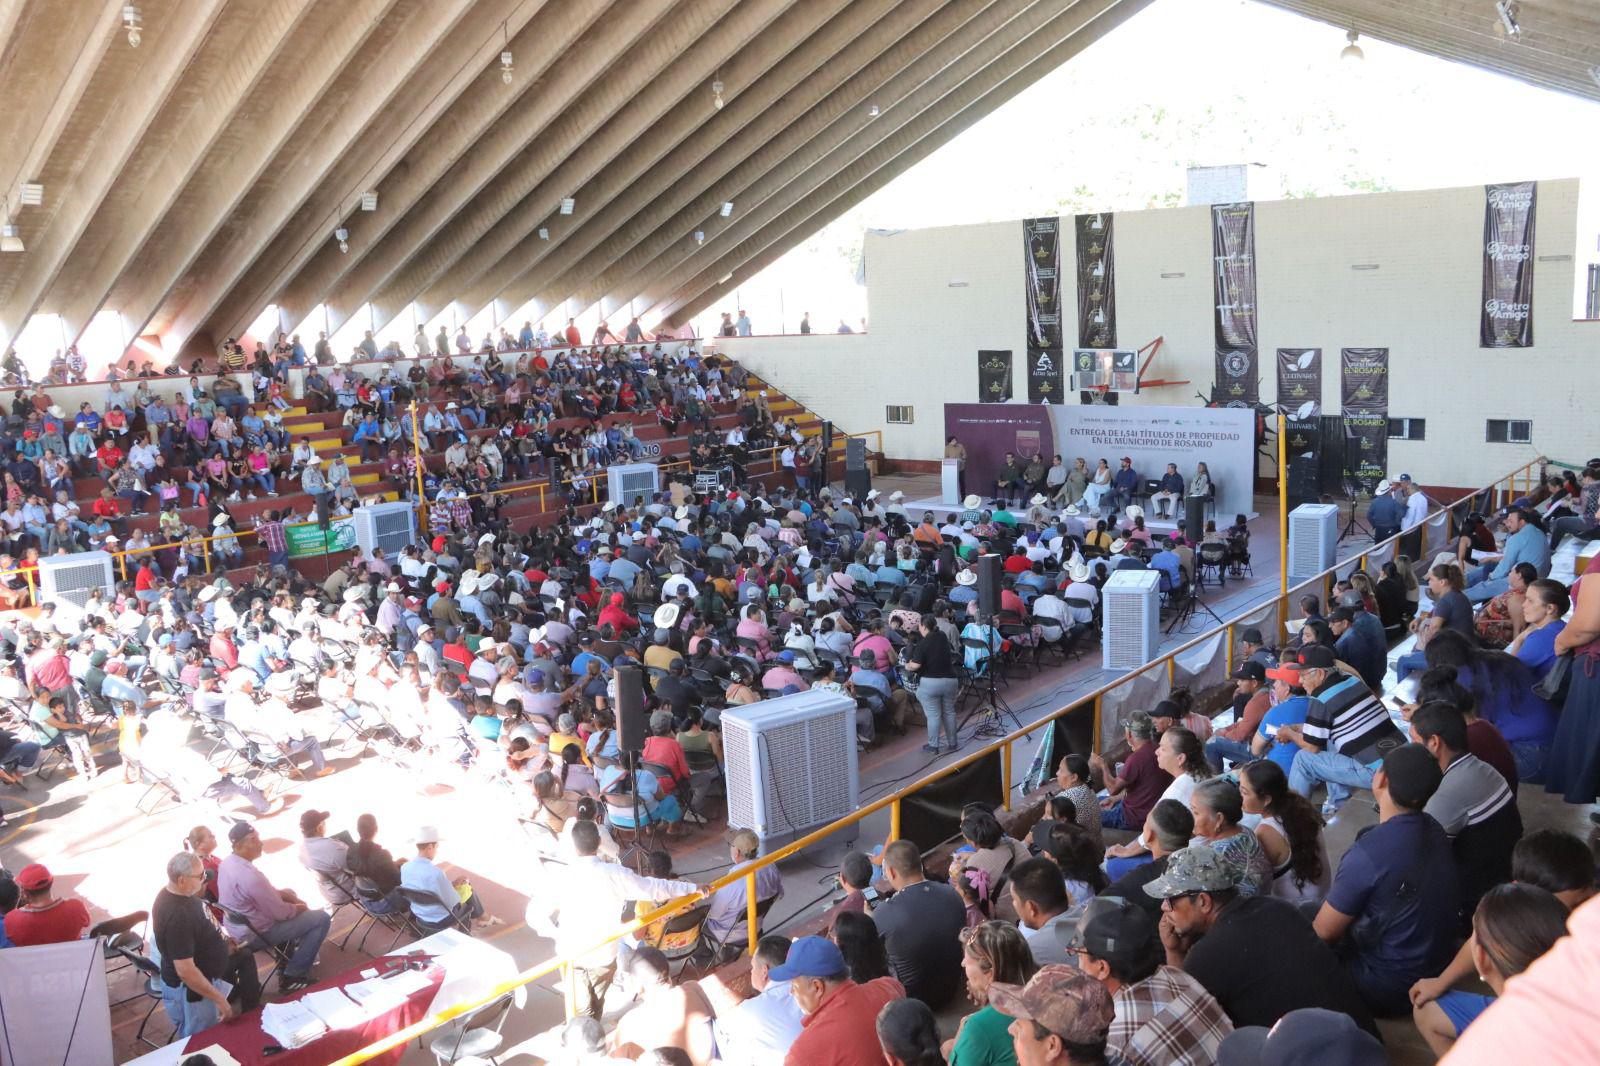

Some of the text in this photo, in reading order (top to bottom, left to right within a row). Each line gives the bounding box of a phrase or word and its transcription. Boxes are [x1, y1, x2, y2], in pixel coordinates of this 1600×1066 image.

[1503, 191, 1532, 200] Petro
[1497, 200, 1531, 211] Amigo
[1501, 244, 1530, 252] Petro
[1496, 252, 1529, 262] Amigo
[1500, 302, 1529, 310] Petro
[1495, 310, 1528, 321] Amigo
[1354, 418, 1386, 426] ROSARIO
[1070, 428, 1107, 437] ENTREGA
[1108, 429, 1119, 437] DE
[1139, 429, 1175, 438] TÍTULOS
[1176, 431, 1187, 439] DE
[1189, 432, 1240, 441] PROPIEDAD
[1092, 436, 1213, 448] EN EL MUNICIPIO DE ROSARIO
